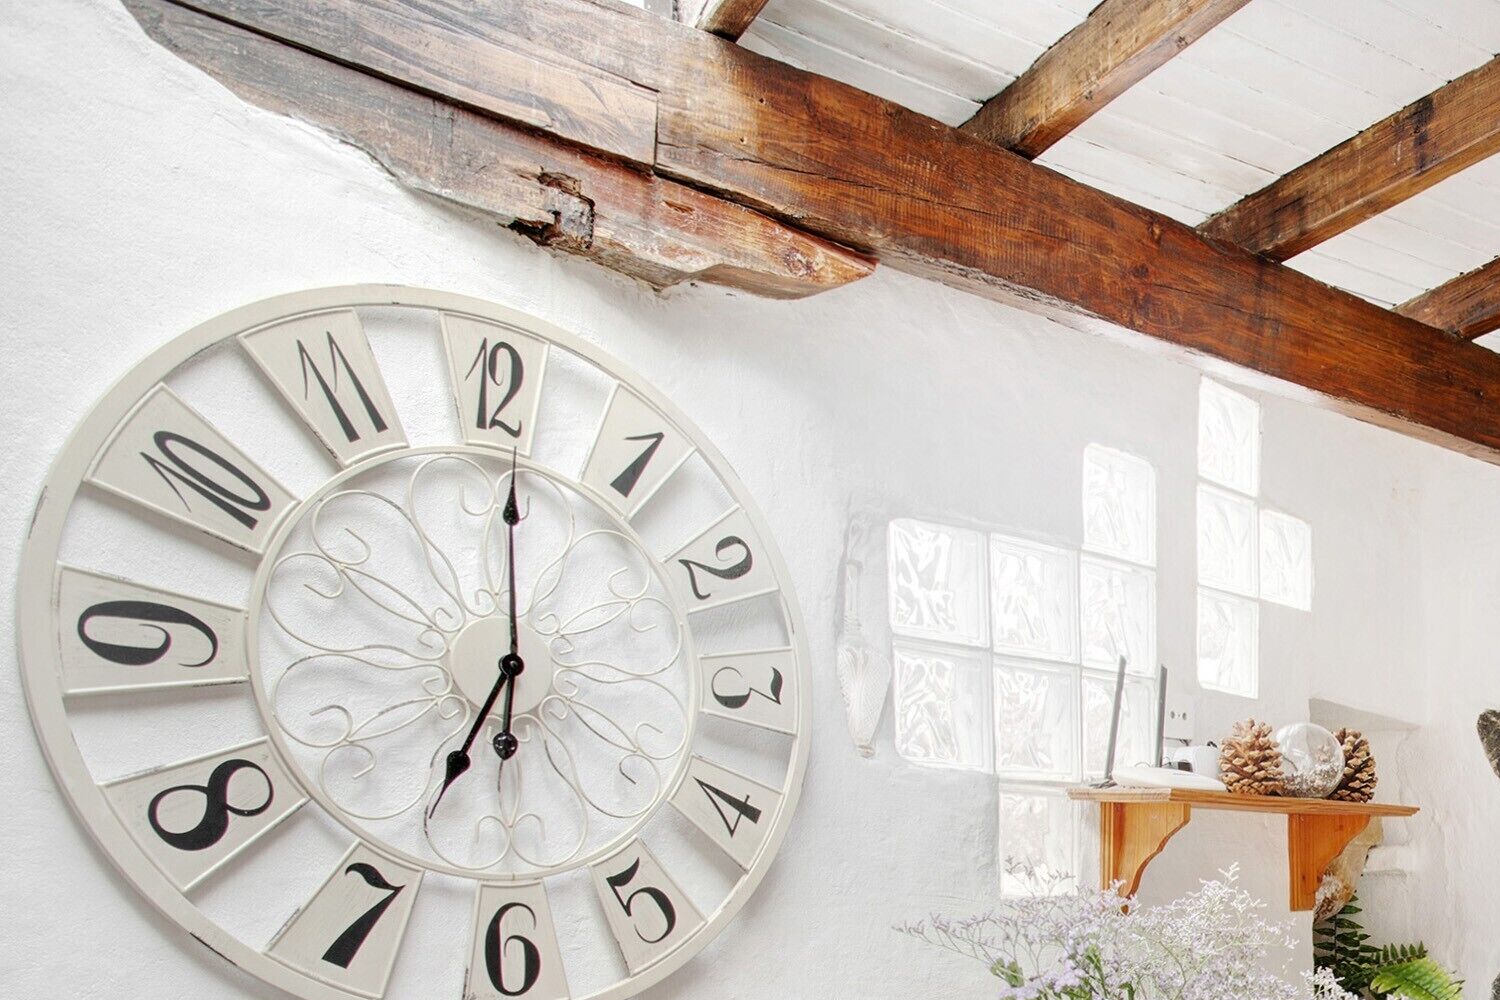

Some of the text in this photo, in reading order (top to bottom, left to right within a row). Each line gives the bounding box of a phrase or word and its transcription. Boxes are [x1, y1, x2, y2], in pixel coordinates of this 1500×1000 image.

[296, 331, 388, 443] 11
[465, 337, 525, 438] 12
[139, 430, 272, 530] 10
[609, 431, 665, 499] 1
[678, 535, 754, 601] 2
[76, 600, 219, 668] 9
[711, 666, 783, 710] 3
[147, 758, 275, 853] 8
[693, 776, 763, 838] 4
[321, 862, 407, 970] 7
[605, 856, 677, 944] 5
[484, 902, 542, 997] 6
